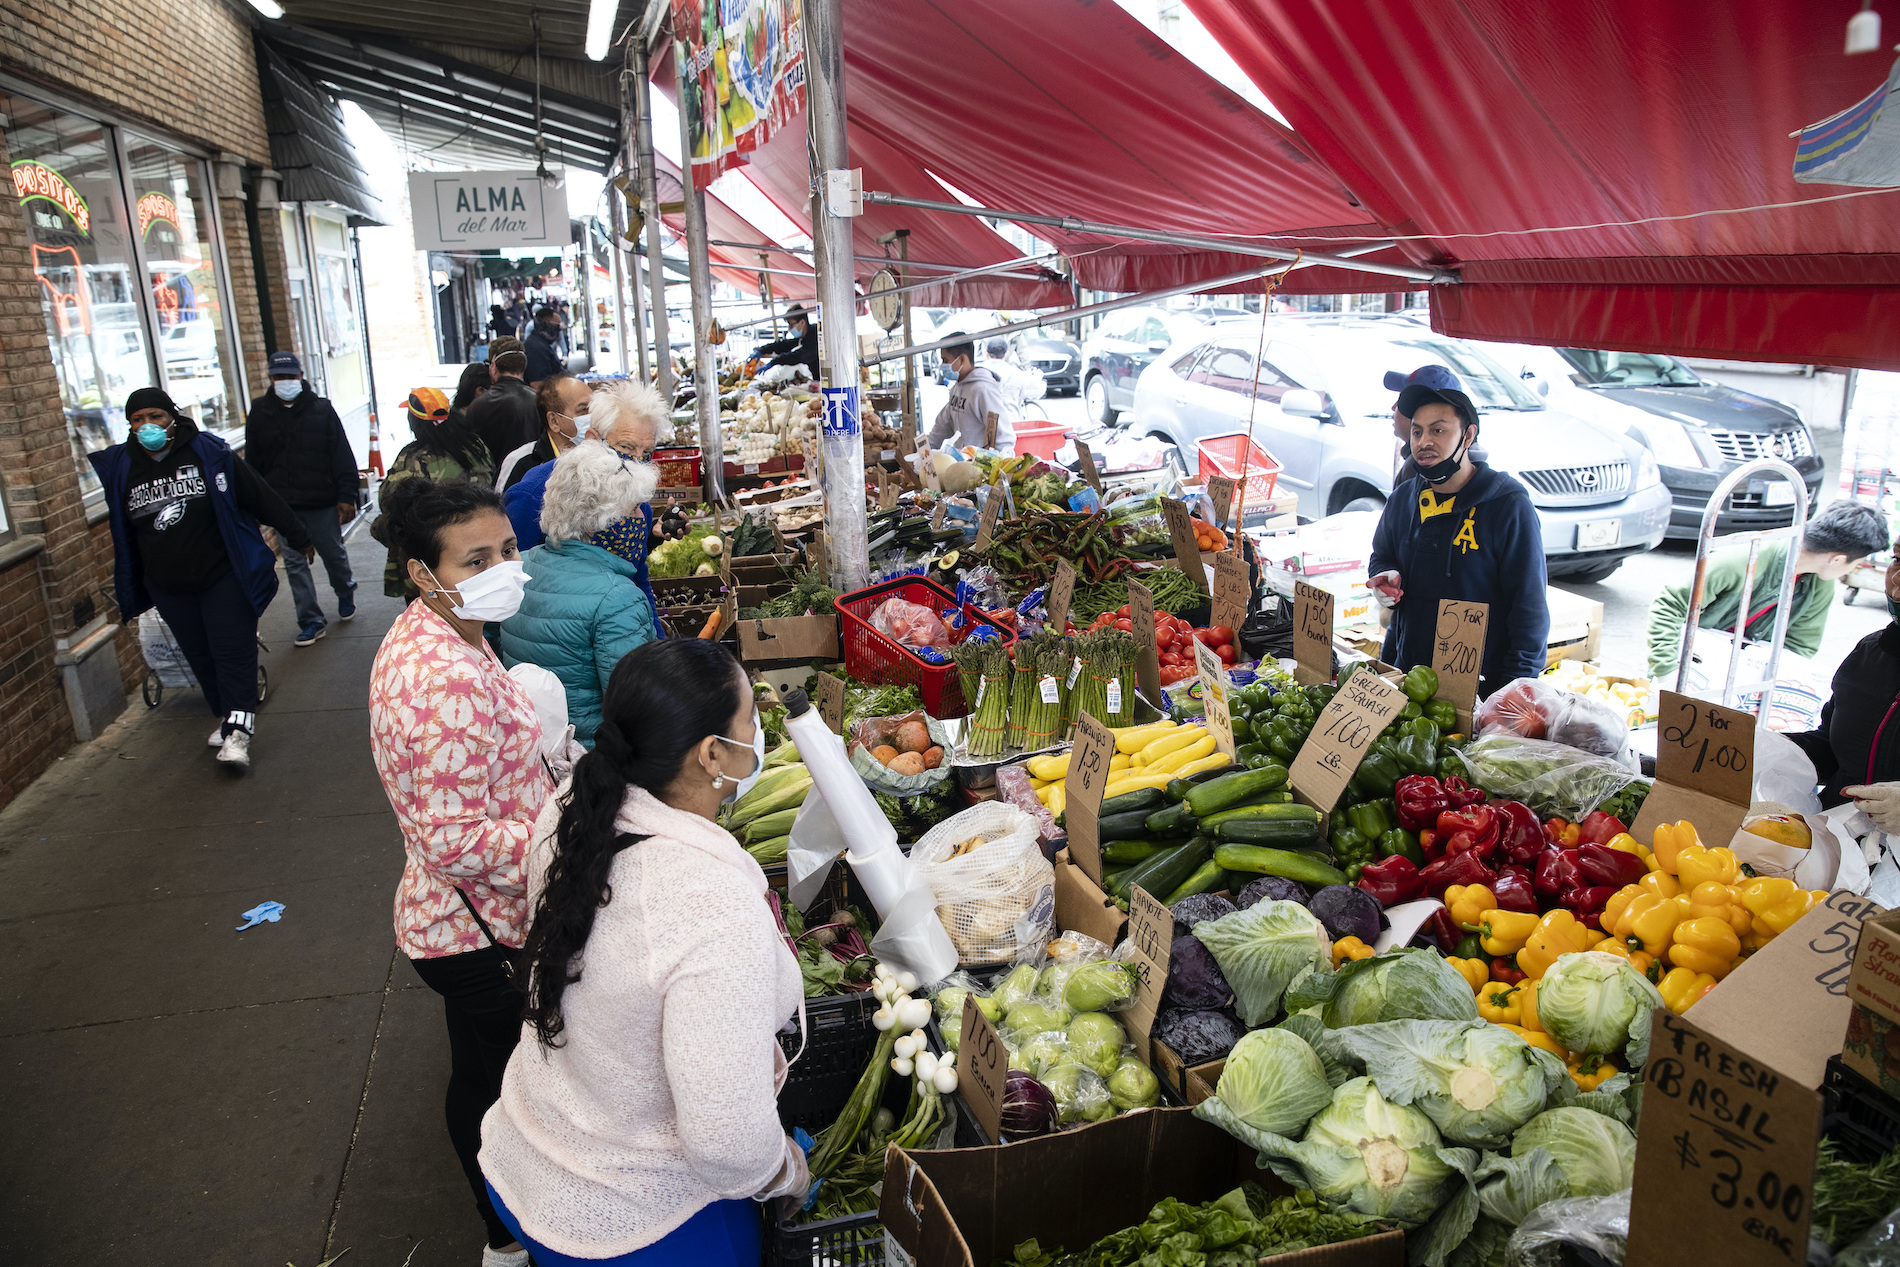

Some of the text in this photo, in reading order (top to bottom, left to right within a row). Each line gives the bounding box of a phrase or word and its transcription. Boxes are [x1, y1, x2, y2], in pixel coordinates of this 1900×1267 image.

[456, 186, 526, 213] ALMA
[457, 216, 529, 234] del Mar
[831, 429, 850, 437] HERE
[128, 476, 207, 511] CHAMPIONS
[1216, 553, 1233, 567] ROMA
[1216, 574, 1227, 599] 3
[1295, 581, 1331, 607] CELERY
[1302, 602, 1328, 632] 1.50
[1436, 602, 1485, 640] 5 FOR
[1307, 624, 1330, 646] bunch
[1437, 641, 1478, 675] $2.00
[820, 673, 840, 692] SWEET
[1352, 671, 1392, 698] GREEN
[1344, 687, 1392, 717] SQUASH
[1663, 704, 1733, 748] 2 for
[1077, 742, 1100, 774] 1.50
[1692, 738, 1747, 773] 1.00
[1131, 887, 1164, 921] CHAYOTE
[1663, 1014, 1779, 1099] FRESH
[1649, 1057, 1776, 1145] BASIL
